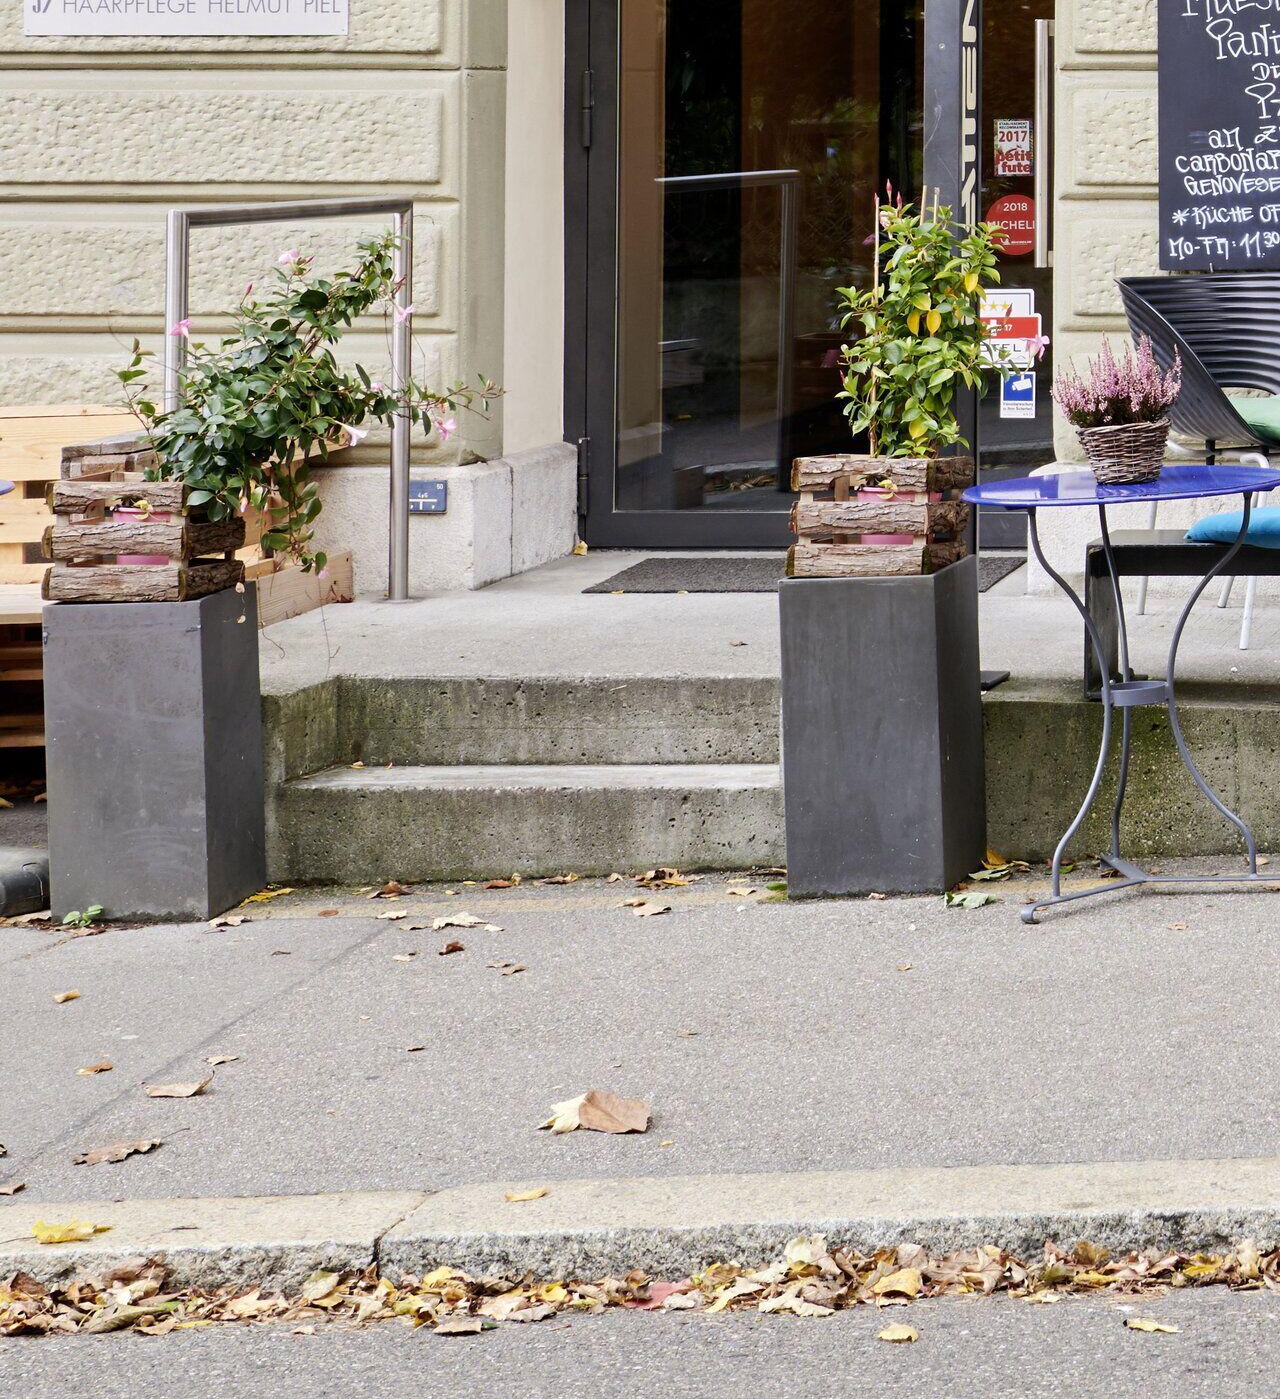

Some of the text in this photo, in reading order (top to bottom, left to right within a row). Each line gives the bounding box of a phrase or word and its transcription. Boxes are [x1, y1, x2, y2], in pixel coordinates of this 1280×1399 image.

[999, 131, 1027, 142] 2017
[1003, 202, 1027, 211] 2018
[987, 220, 1034, 229] MICHELI
